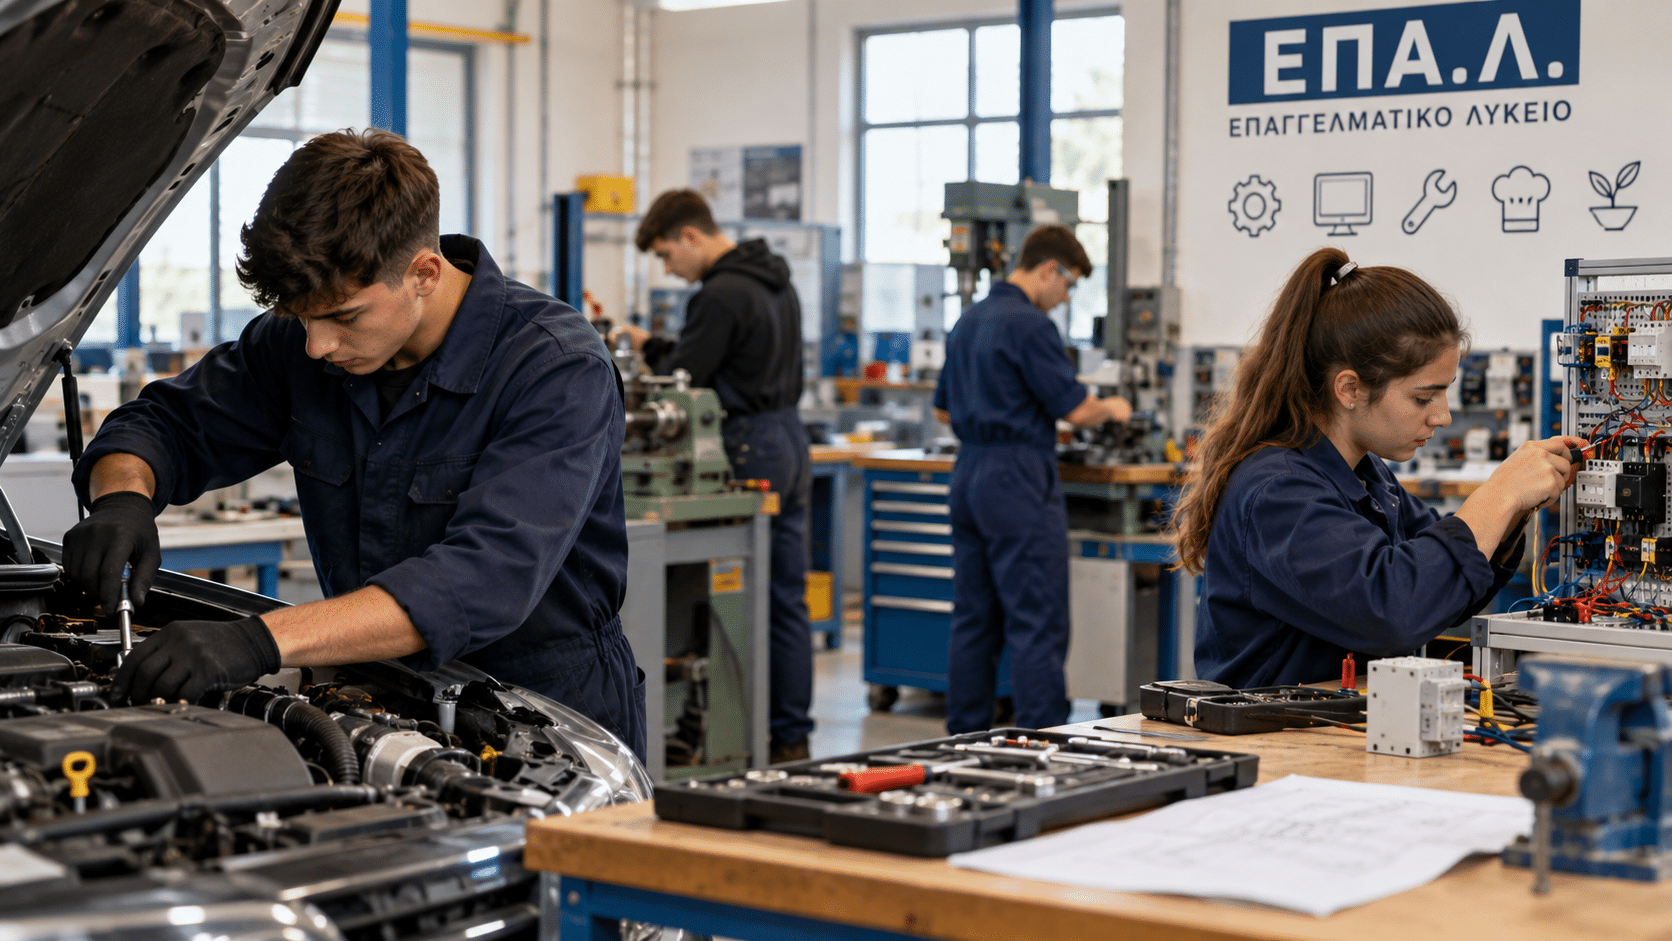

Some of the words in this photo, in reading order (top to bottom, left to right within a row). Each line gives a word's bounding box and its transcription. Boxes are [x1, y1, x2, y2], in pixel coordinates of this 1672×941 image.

[1263, 12, 1565, 96] ΕΠΑ.Λ.
[1229, 106, 1453, 138] ΕΠΑΓΓΕΛΜΑΤΙΚΟ
[1466, 99, 1572, 126] ΛΥΚΕΙΟ
